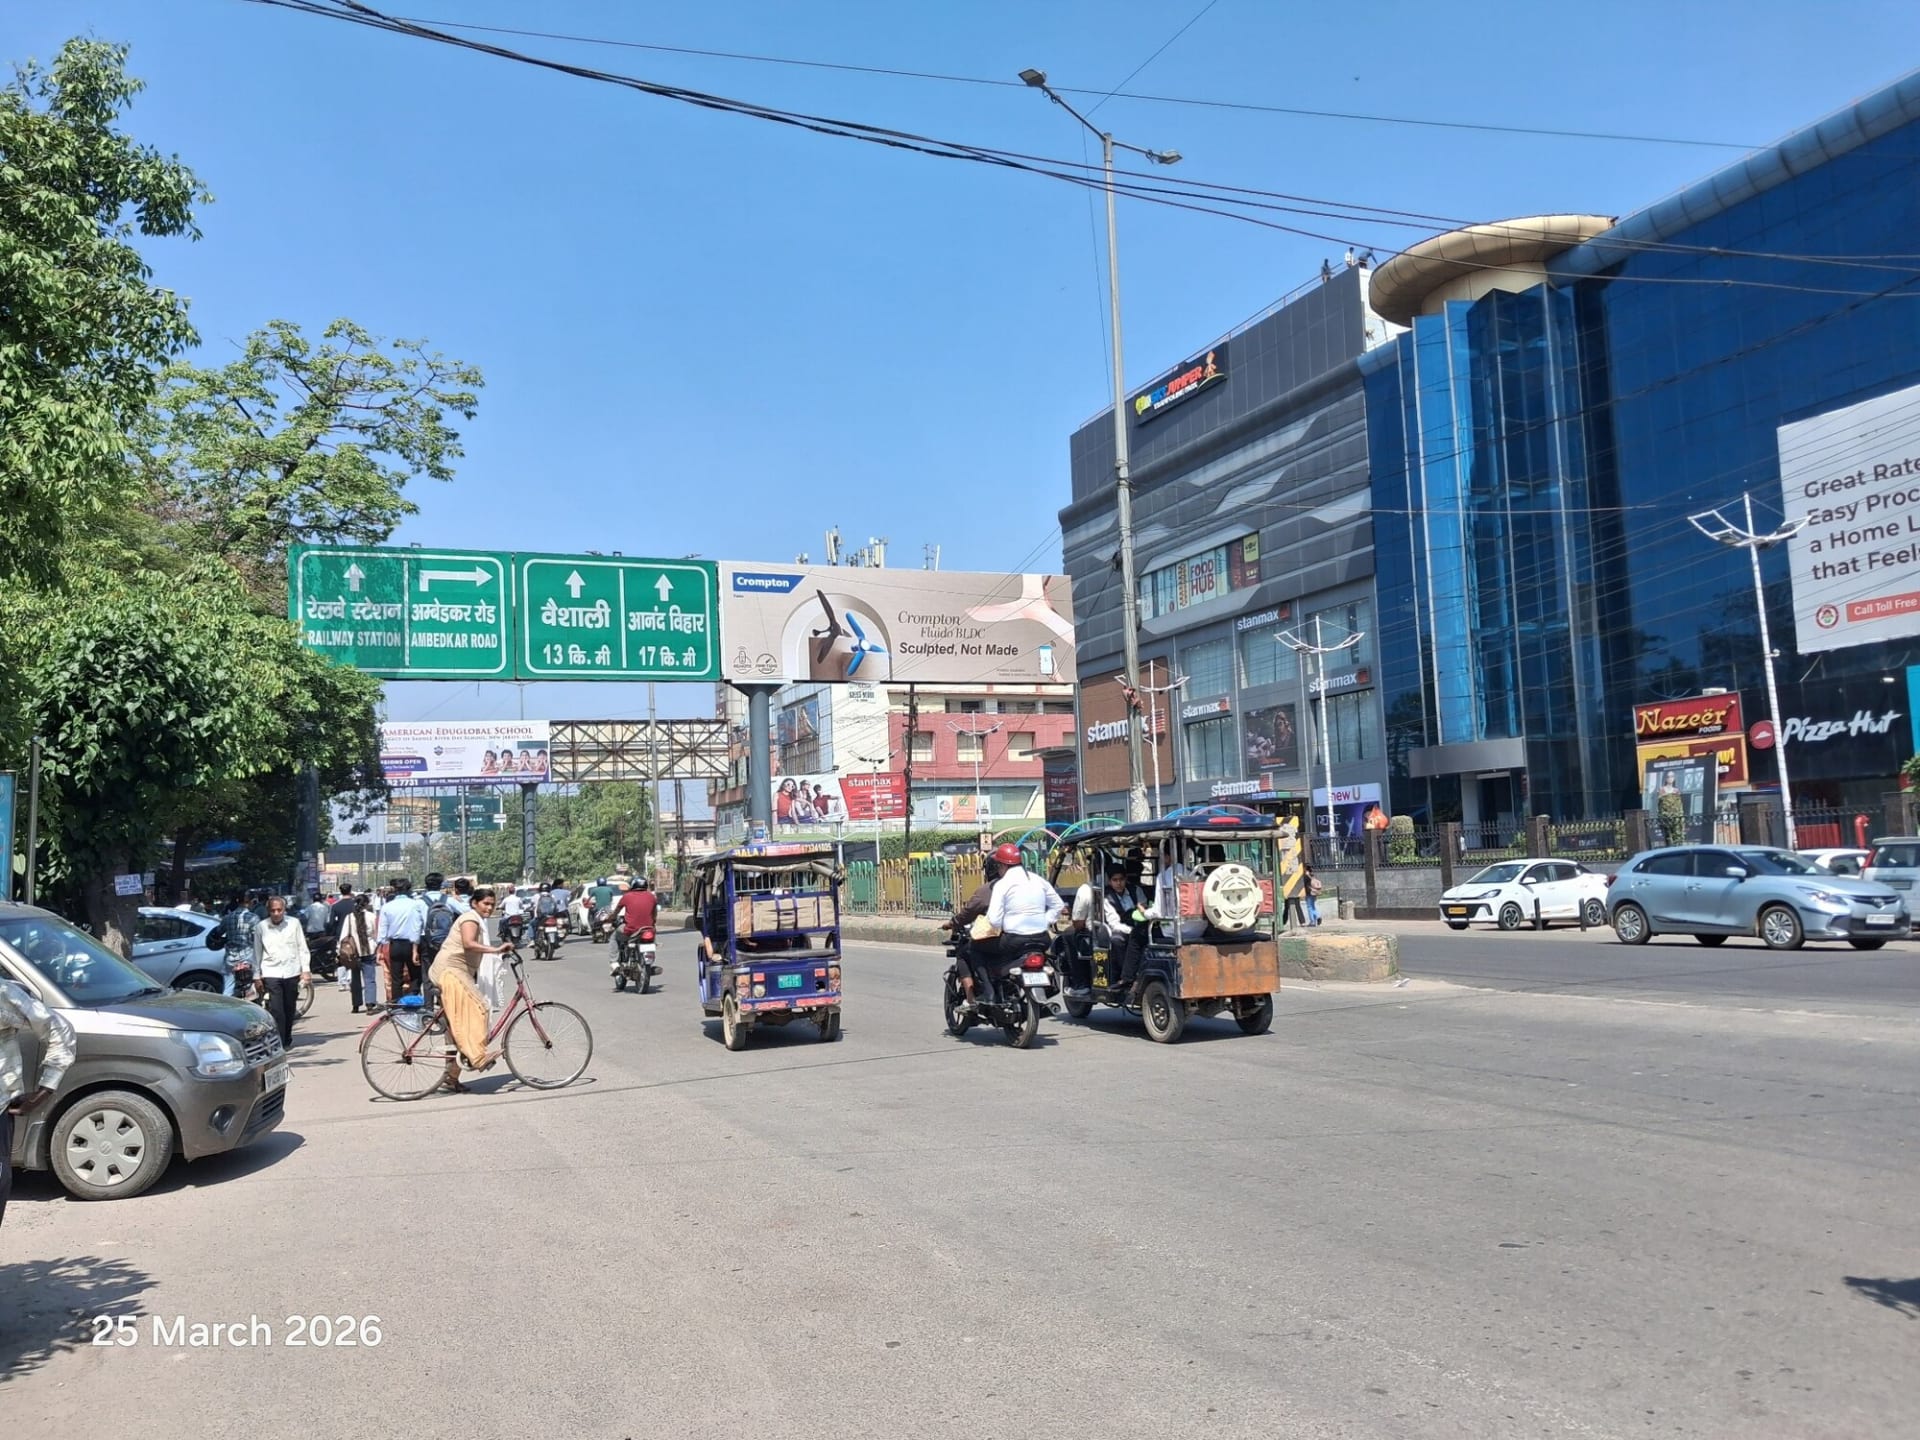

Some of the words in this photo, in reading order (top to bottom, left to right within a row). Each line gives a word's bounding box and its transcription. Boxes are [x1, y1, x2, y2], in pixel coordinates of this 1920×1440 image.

[1805, 470, 1867, 498] Great
[1807, 502, 1859, 527] Easy
[1866, 488, 1920, 512] Proc
[1810, 539, 1822, 553] a
[1831, 521, 1900, 549] Home
[1191, 560, 1214, 579] FOOD
[1811, 556, 1861, 581] that
[1868, 543, 1920, 570] Feel
[737, 577, 790, 589] Crompton
[1191, 573, 1215, 597] HUB
[306, 595, 346, 620] रेलवे
[351, 596, 402, 621] स्टेशन
[474, 599, 496, 624] रोड
[541, 597, 611, 629] वैशाली
[1854, 604, 1873, 616] Call
[1876, 600, 1893, 613] Toll
[1895, 597, 1918, 610] Free
[628, 606, 666, 632] आनंद
[669, 605, 705, 634] विहार
[898, 610, 960, 628] Crompton
[1237, 609, 1279, 630] stanmax
[307, 630, 354, 647] RAILWAY
[357, 631, 401, 647] STATION
[411, 632, 469, 648] AMBEDKAR
[471, 633, 498, 648] ROAD
[956, 628, 985, 640] BLDC
[543, 644, 563, 665] 13
[595, 645, 611, 666] मी
[639, 646, 656, 667] 17
[682, 647, 696, 667] मी
[900, 642, 957, 657] Sculpted,
[961, 644, 981, 656] Not
[986, 644, 1018, 656] Made
[1182, 702, 1220, 718] stanmax
[495, 726, 533, 735] SCHOOL
[1782, 716, 1848, 746] Pizza
[1848, 710, 1903, 737] Hut
[847, 778, 892, 788] stanmax
[1211, 780, 1260, 797] stanmax
